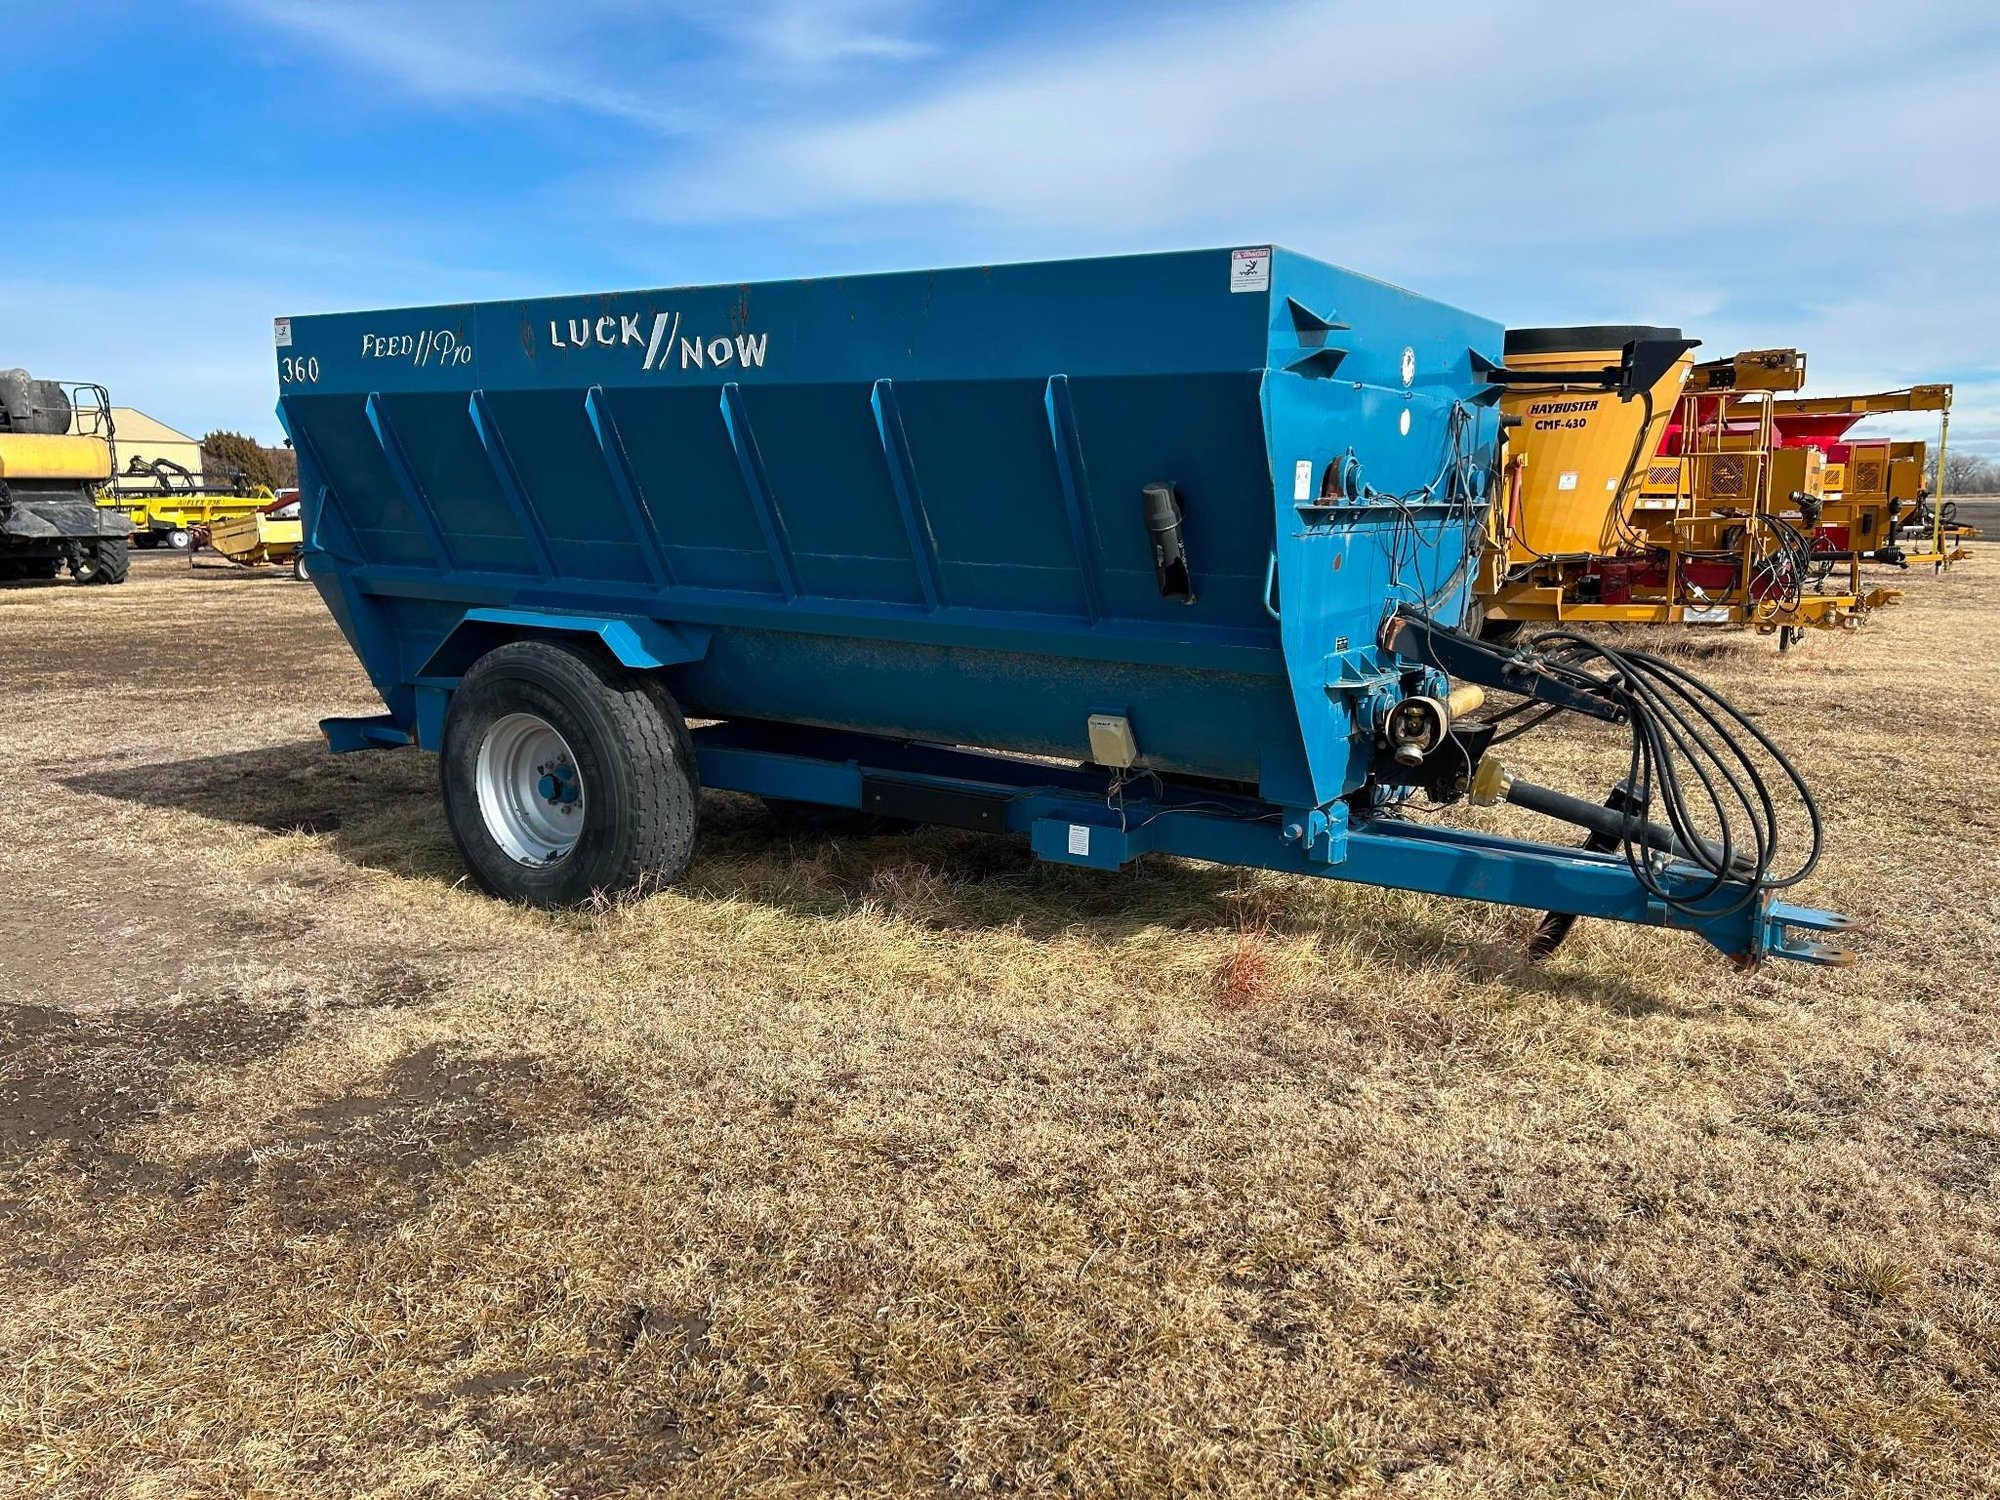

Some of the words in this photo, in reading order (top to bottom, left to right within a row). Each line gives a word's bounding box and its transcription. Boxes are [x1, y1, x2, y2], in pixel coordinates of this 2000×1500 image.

[550, 312, 645, 347] LUCK
[680, 333, 767, 369] NOW
[282, 356, 319, 383] 360
[1530, 401, 1597, 414] HAYBUSTER
[1535, 418, 1586, 430] CMF-430
